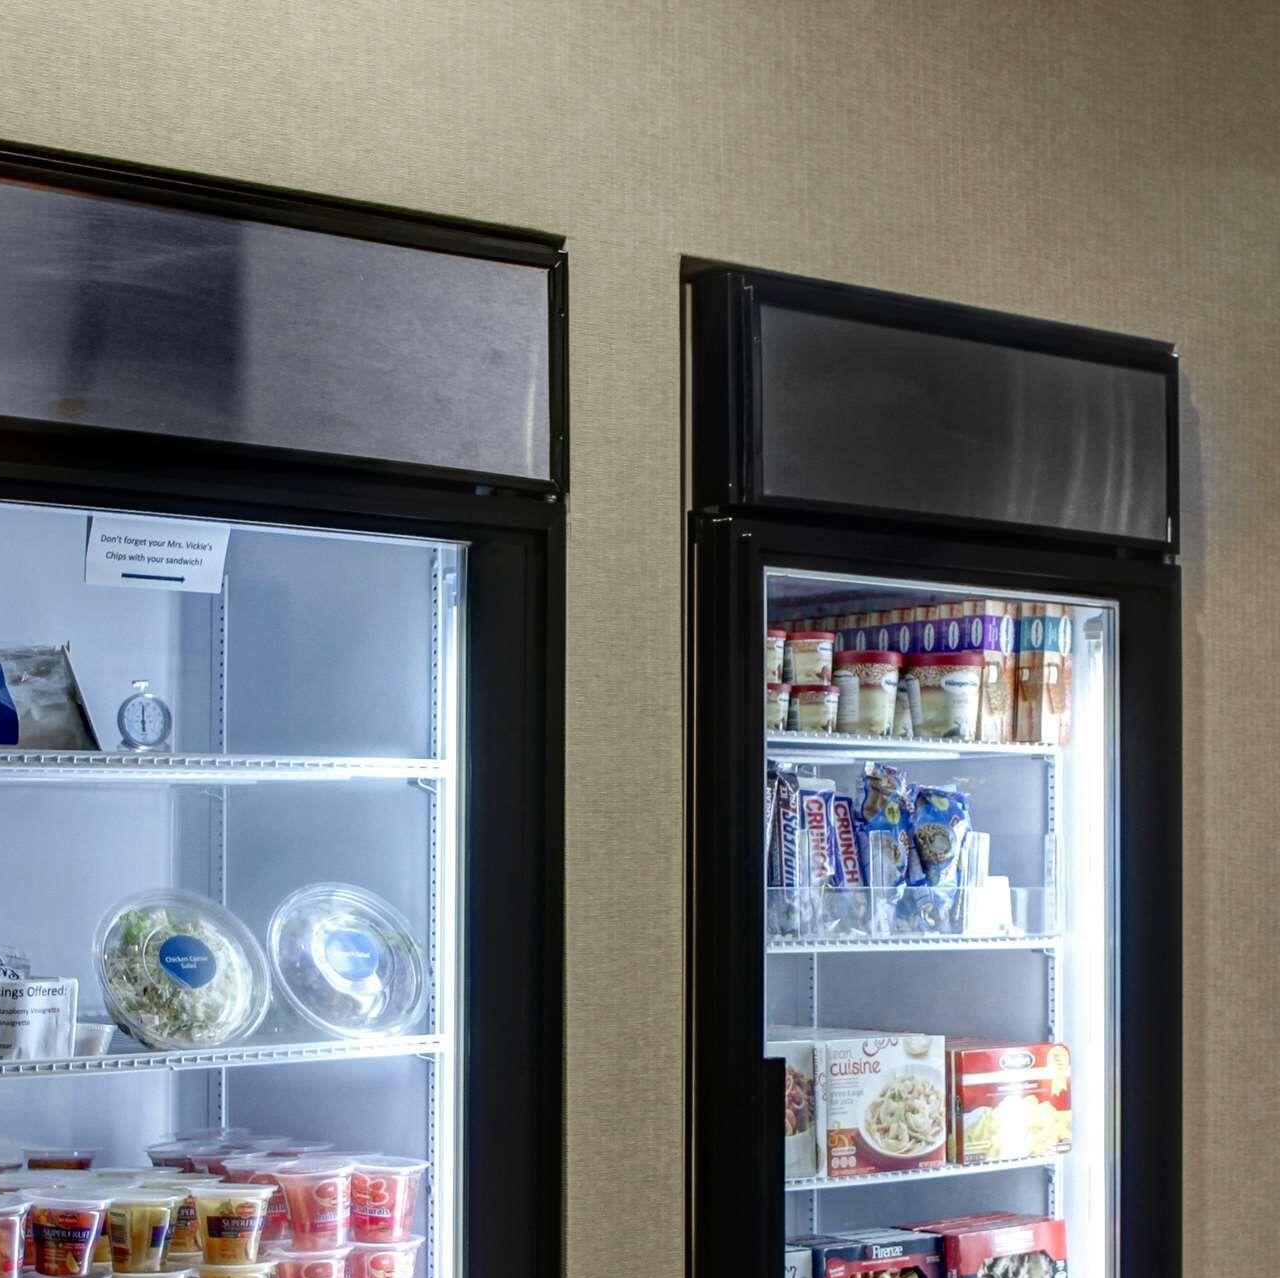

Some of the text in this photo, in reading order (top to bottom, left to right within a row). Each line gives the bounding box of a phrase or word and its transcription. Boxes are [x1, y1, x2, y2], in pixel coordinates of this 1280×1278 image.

[100, 534, 213, 551] Don't forget your Mrs. Vickie's
[105, 551, 127, 561] Chips
[147, 556, 164, 564] your
[165, 557, 203, 566] sandwich!
[833, 802, 859, 885] CRUNCH
[165, 955, 189, 963] Chicken
[27, 985, 68, 997] Offered:
[830, 1059, 881, 1077] cuisine
[872, 1245, 904, 1259] Firenze
